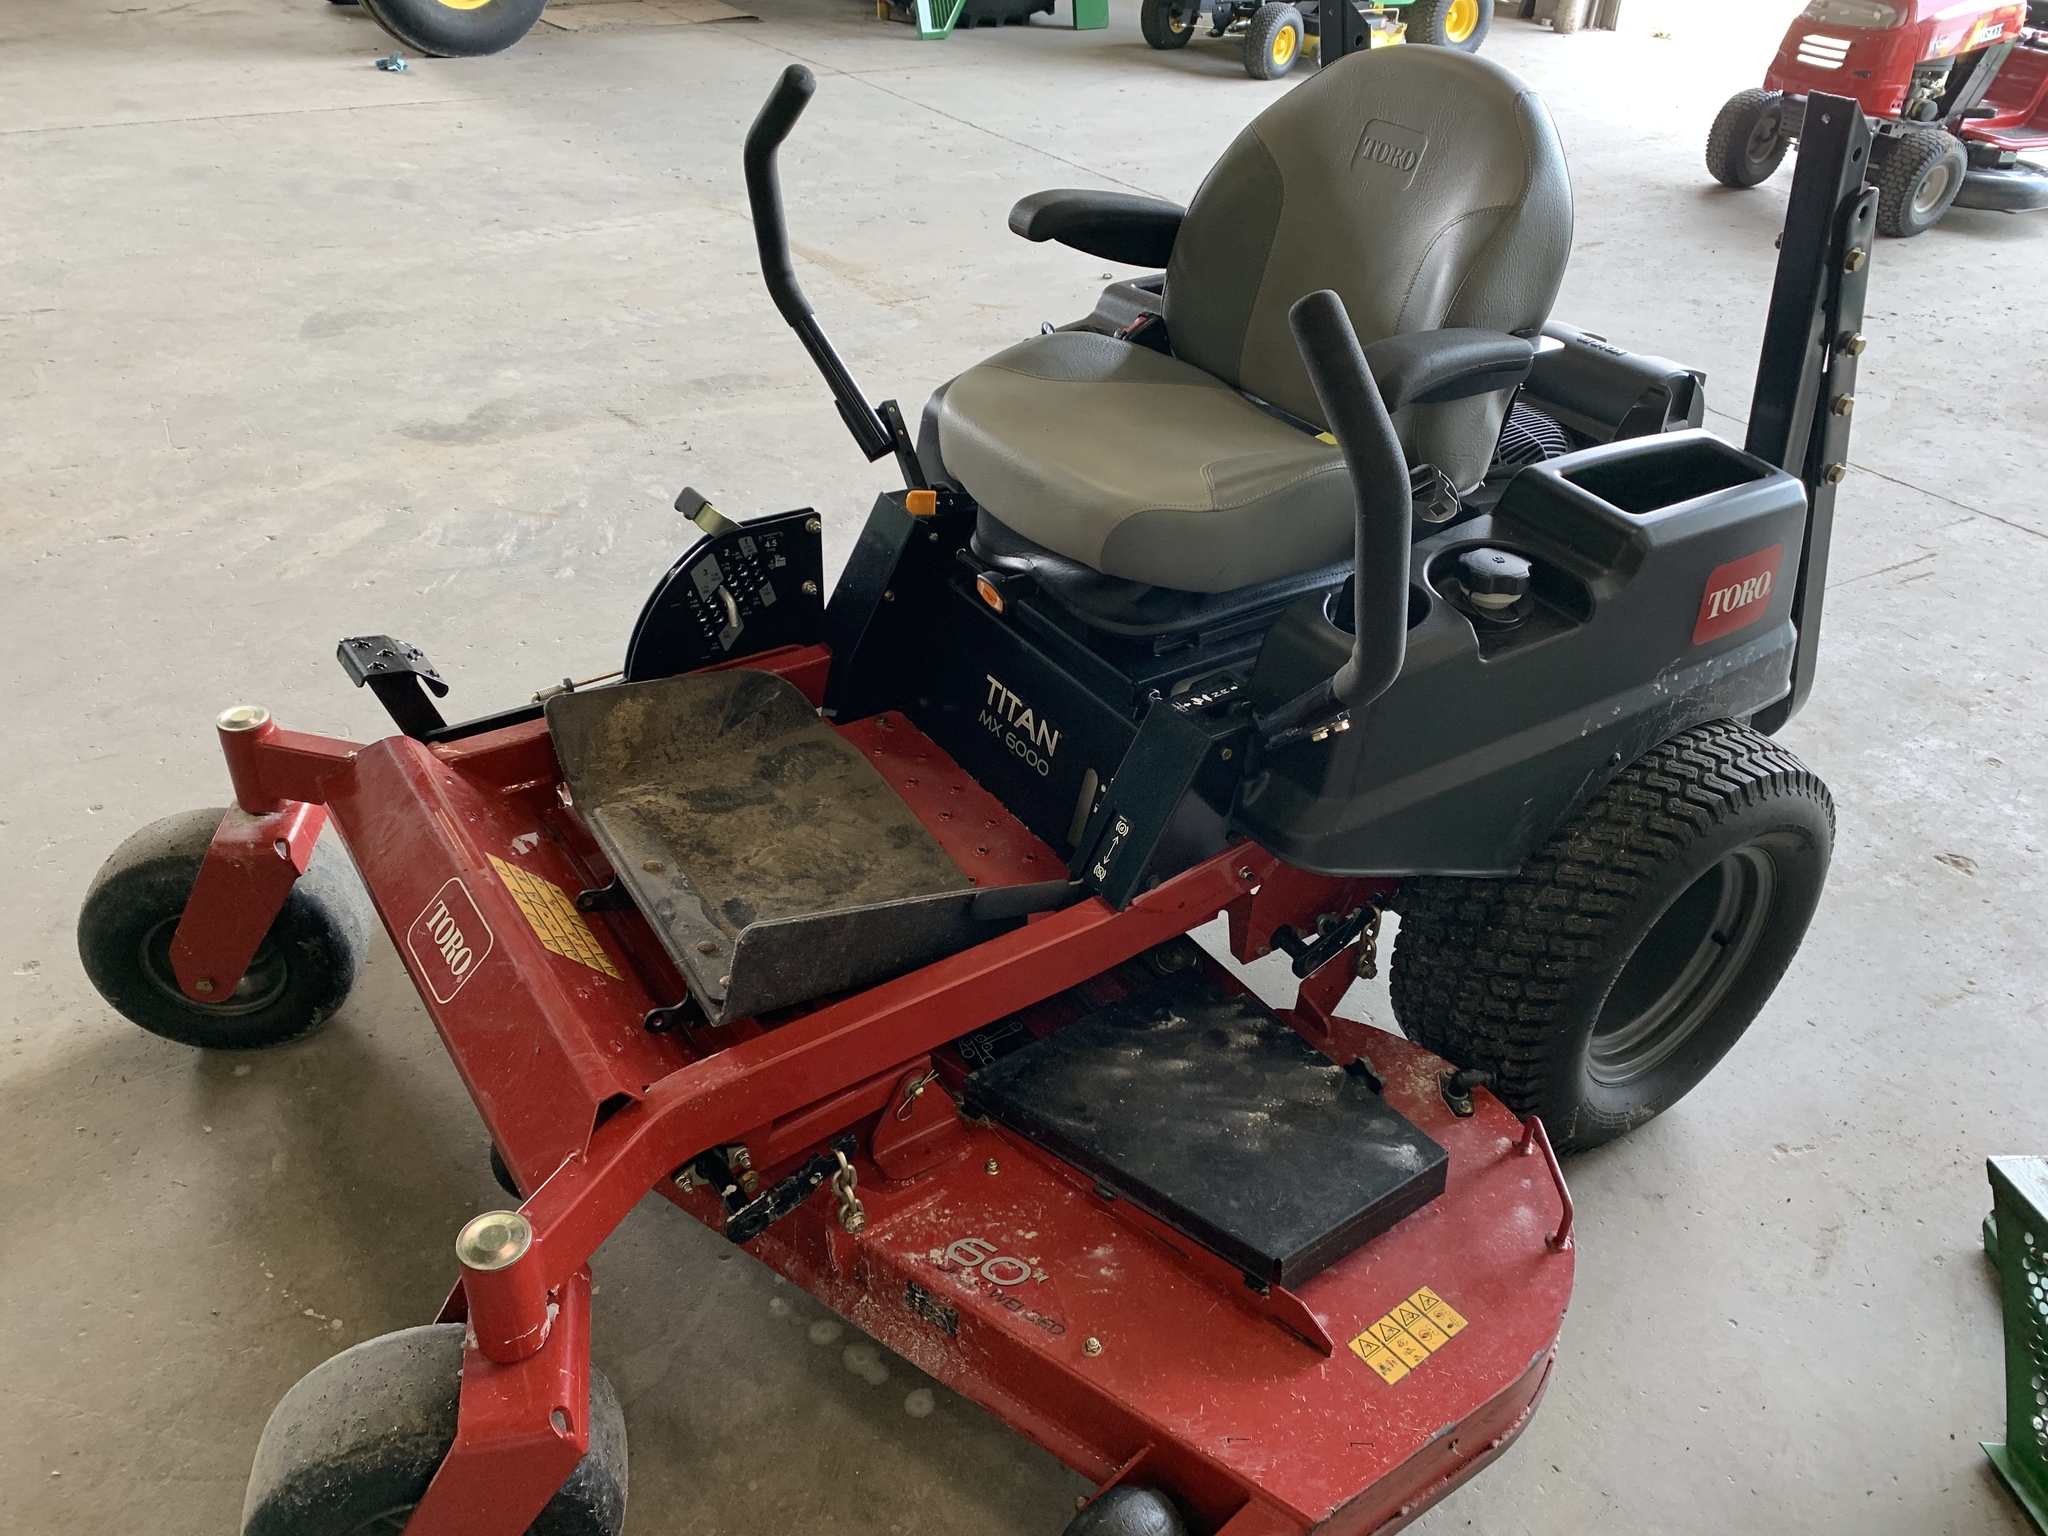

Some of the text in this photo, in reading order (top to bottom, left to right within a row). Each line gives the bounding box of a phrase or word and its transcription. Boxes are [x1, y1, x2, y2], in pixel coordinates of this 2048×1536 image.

[1362, 136, 1417, 171] TORO
[724, 548, 730, 557] 2
[765, 539, 778, 549] 4.5
[1706, 570, 1772, 620] TORO
[986, 673, 1060, 758] TITAN
[978, 708, 1049, 776] MX 6000
[425, 899, 473, 977] TORO
